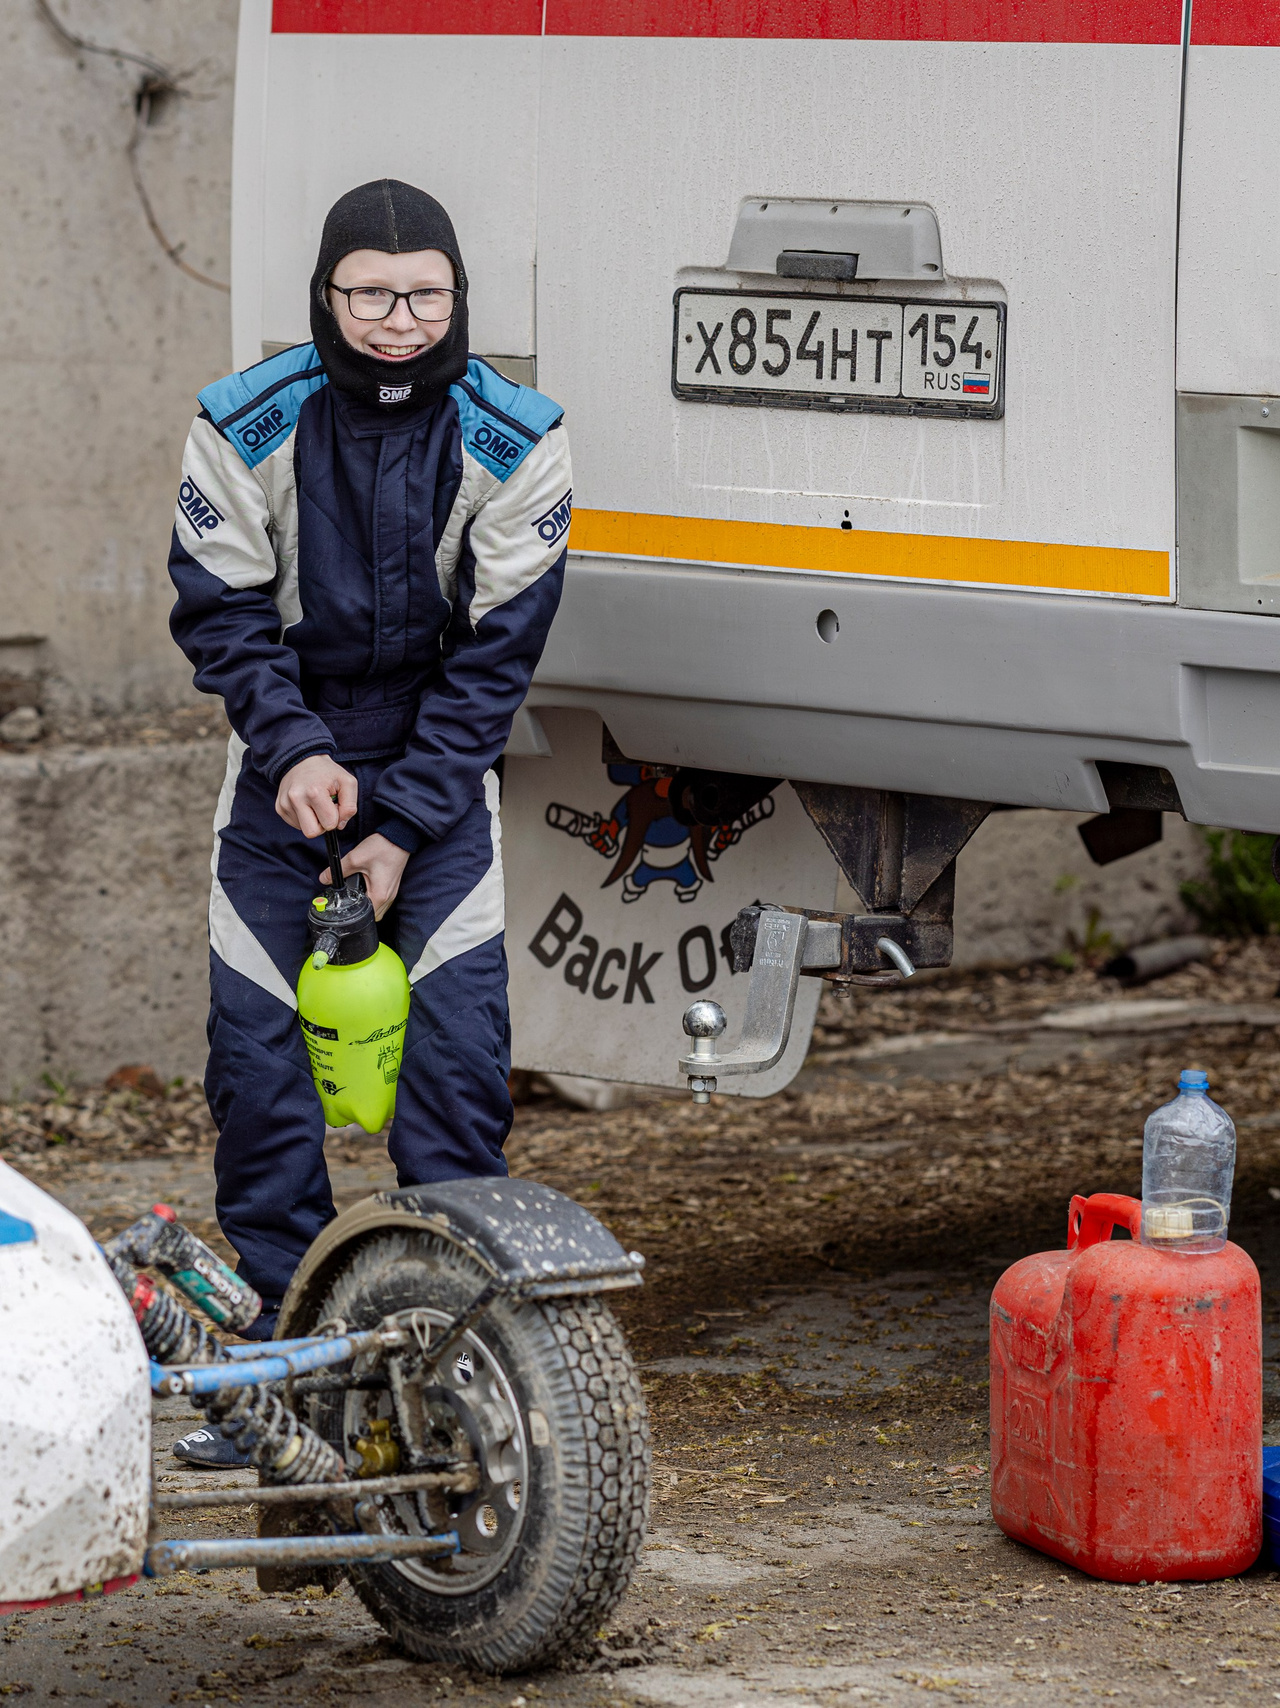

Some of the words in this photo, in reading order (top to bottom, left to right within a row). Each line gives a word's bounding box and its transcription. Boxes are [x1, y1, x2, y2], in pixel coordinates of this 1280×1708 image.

[908, 312, 983, 369] 154
[379, 388, 412, 400] OMP
[923, 372, 961, 391] RUS
[242, 408, 284, 448] OMP
[474, 426, 520, 462] OMP
[179, 481, 219, 530] OMP
[528, 892, 663, 1005] Back
